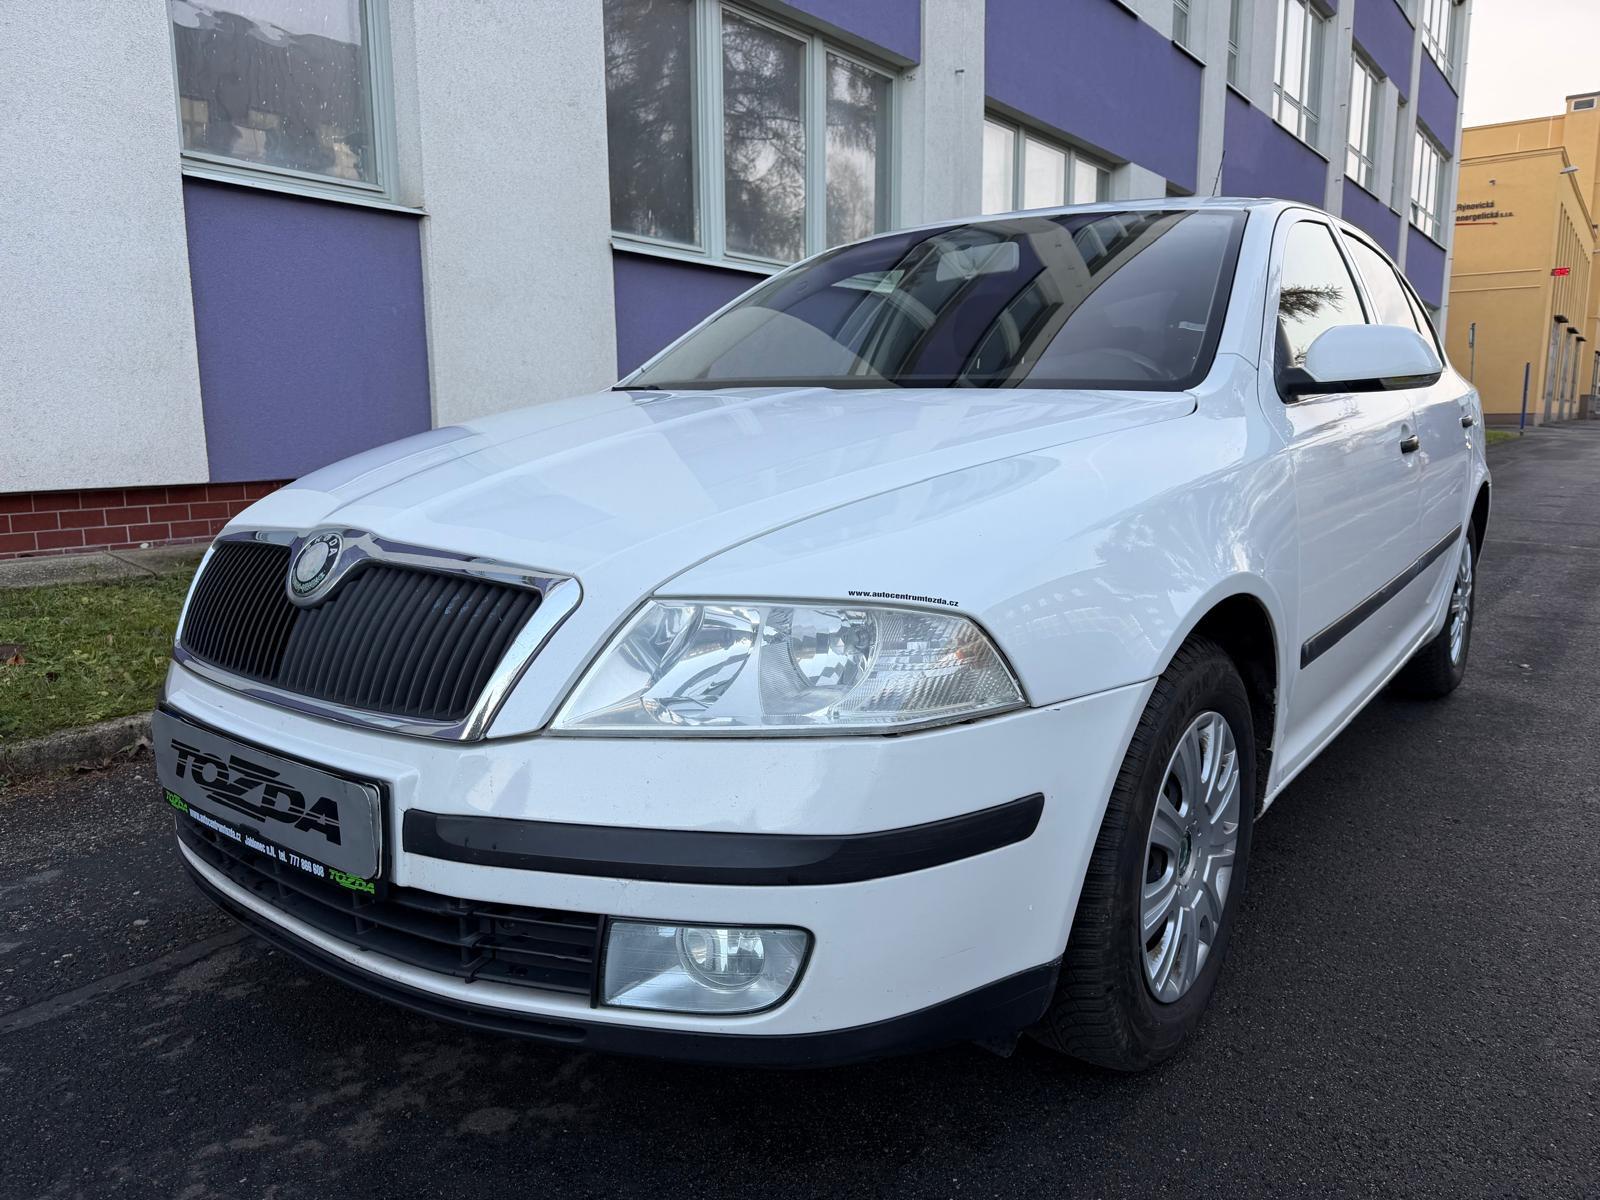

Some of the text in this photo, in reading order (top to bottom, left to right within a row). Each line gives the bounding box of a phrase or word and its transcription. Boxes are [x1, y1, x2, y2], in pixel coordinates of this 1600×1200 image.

[848, 590, 959, 607] www.autocentrumtozda.cz
[171, 738, 341, 846] TOZDA
[328, 868, 375, 895] TOZDA
